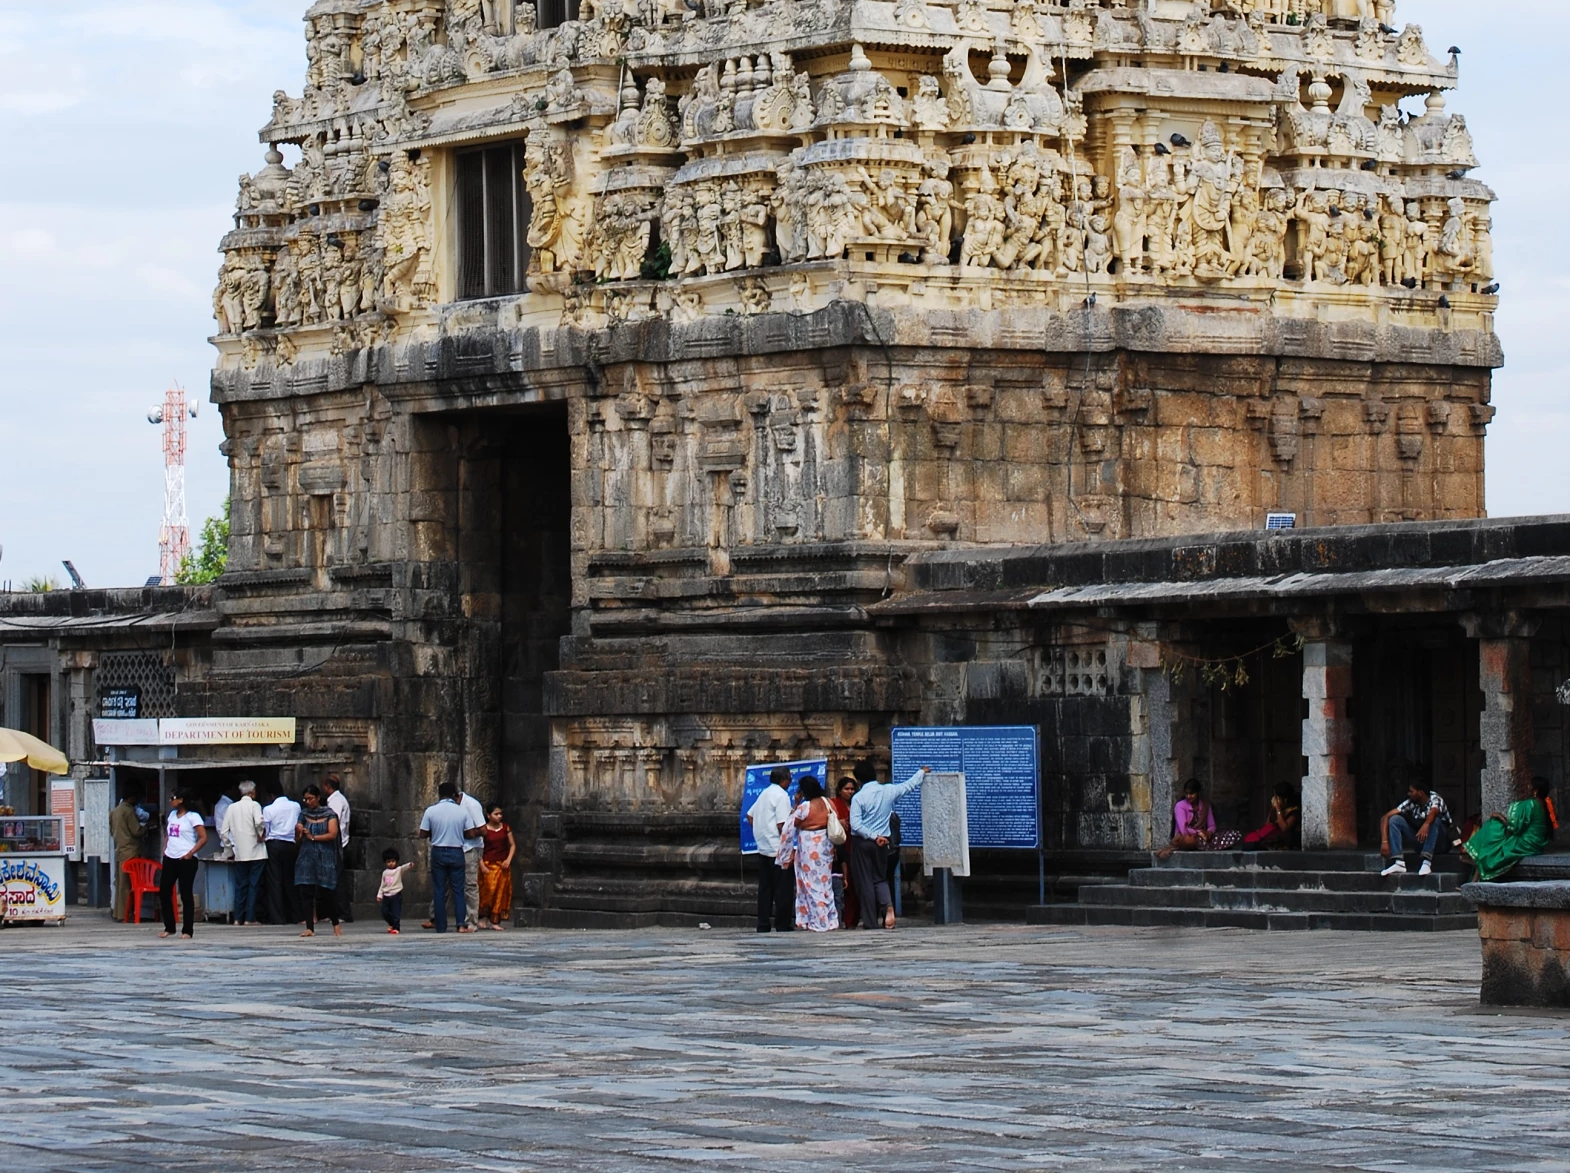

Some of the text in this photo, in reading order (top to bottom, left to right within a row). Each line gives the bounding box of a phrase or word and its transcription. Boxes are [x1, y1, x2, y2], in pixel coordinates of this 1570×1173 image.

[164, 730, 291, 739] DEPARTMENT OF TOURISM
